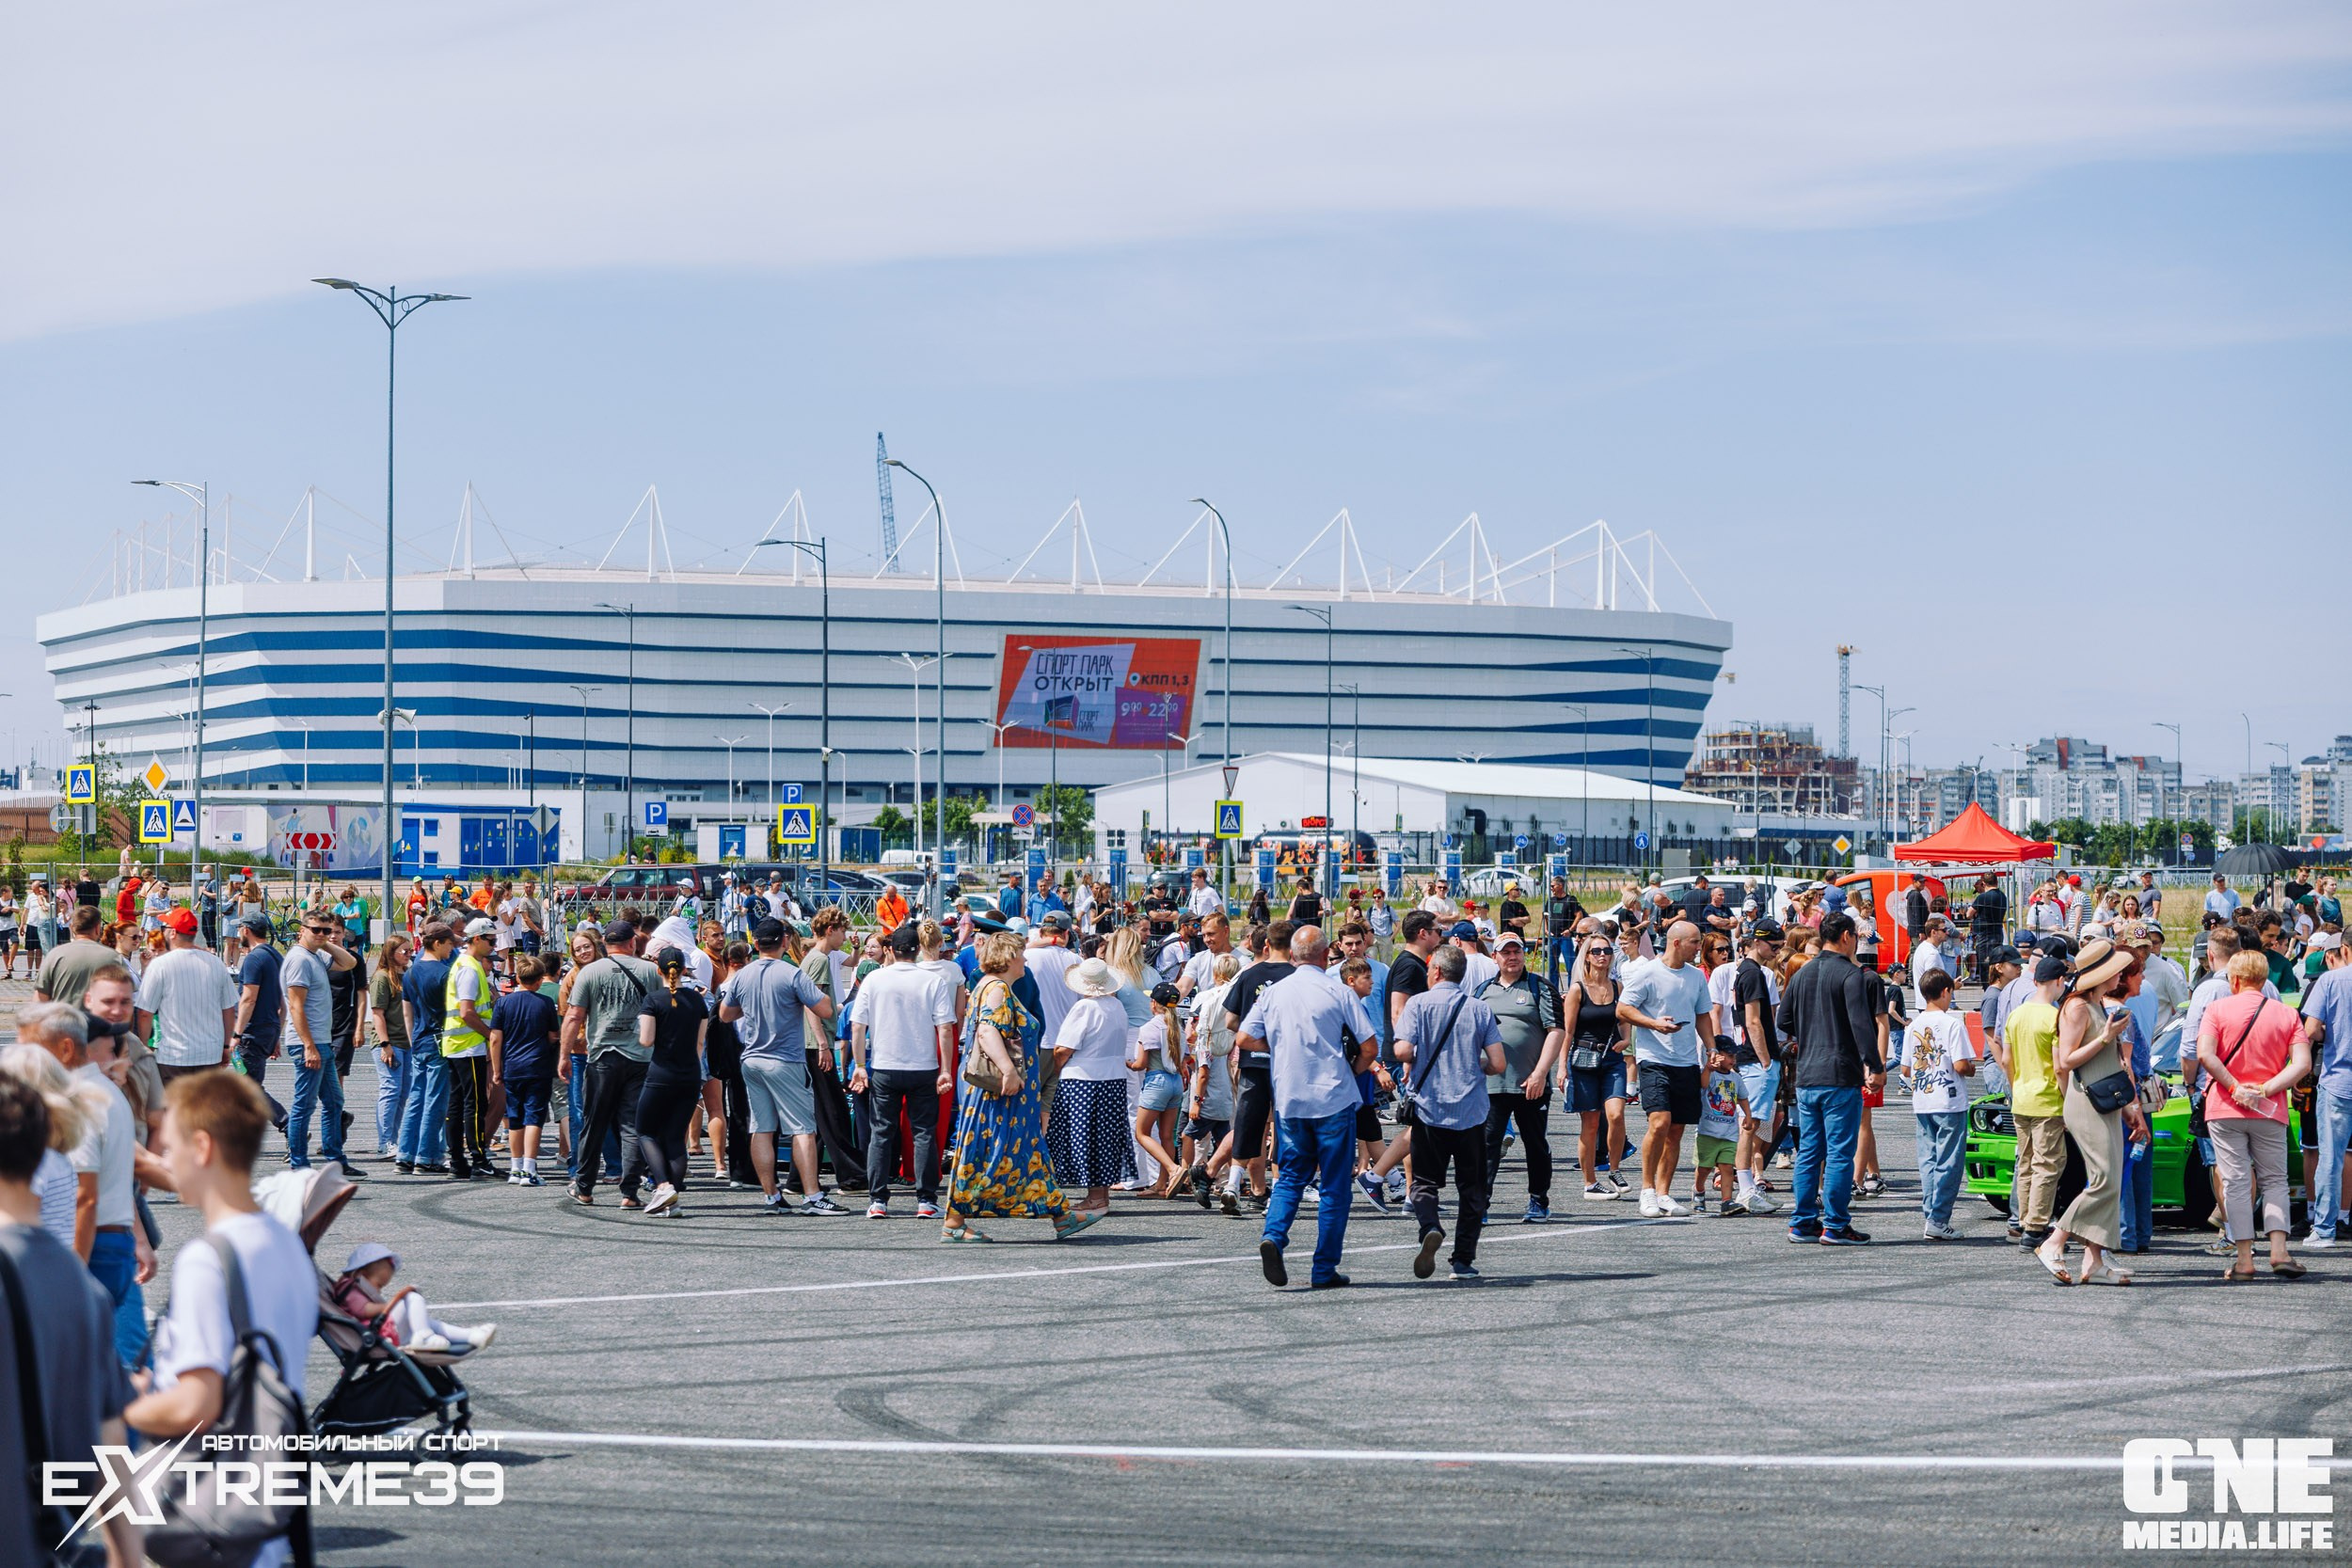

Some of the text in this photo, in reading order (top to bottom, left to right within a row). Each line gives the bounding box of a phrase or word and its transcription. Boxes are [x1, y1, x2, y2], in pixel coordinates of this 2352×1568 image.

[1036, 654, 1114, 675] СПОРТ ПАРК
[1035, 676, 1114, 691] ОТКРЫТ
[1141, 674, 1168, 685] КПП
[787, 786, 799, 802] P
[649, 804, 662, 823] P
